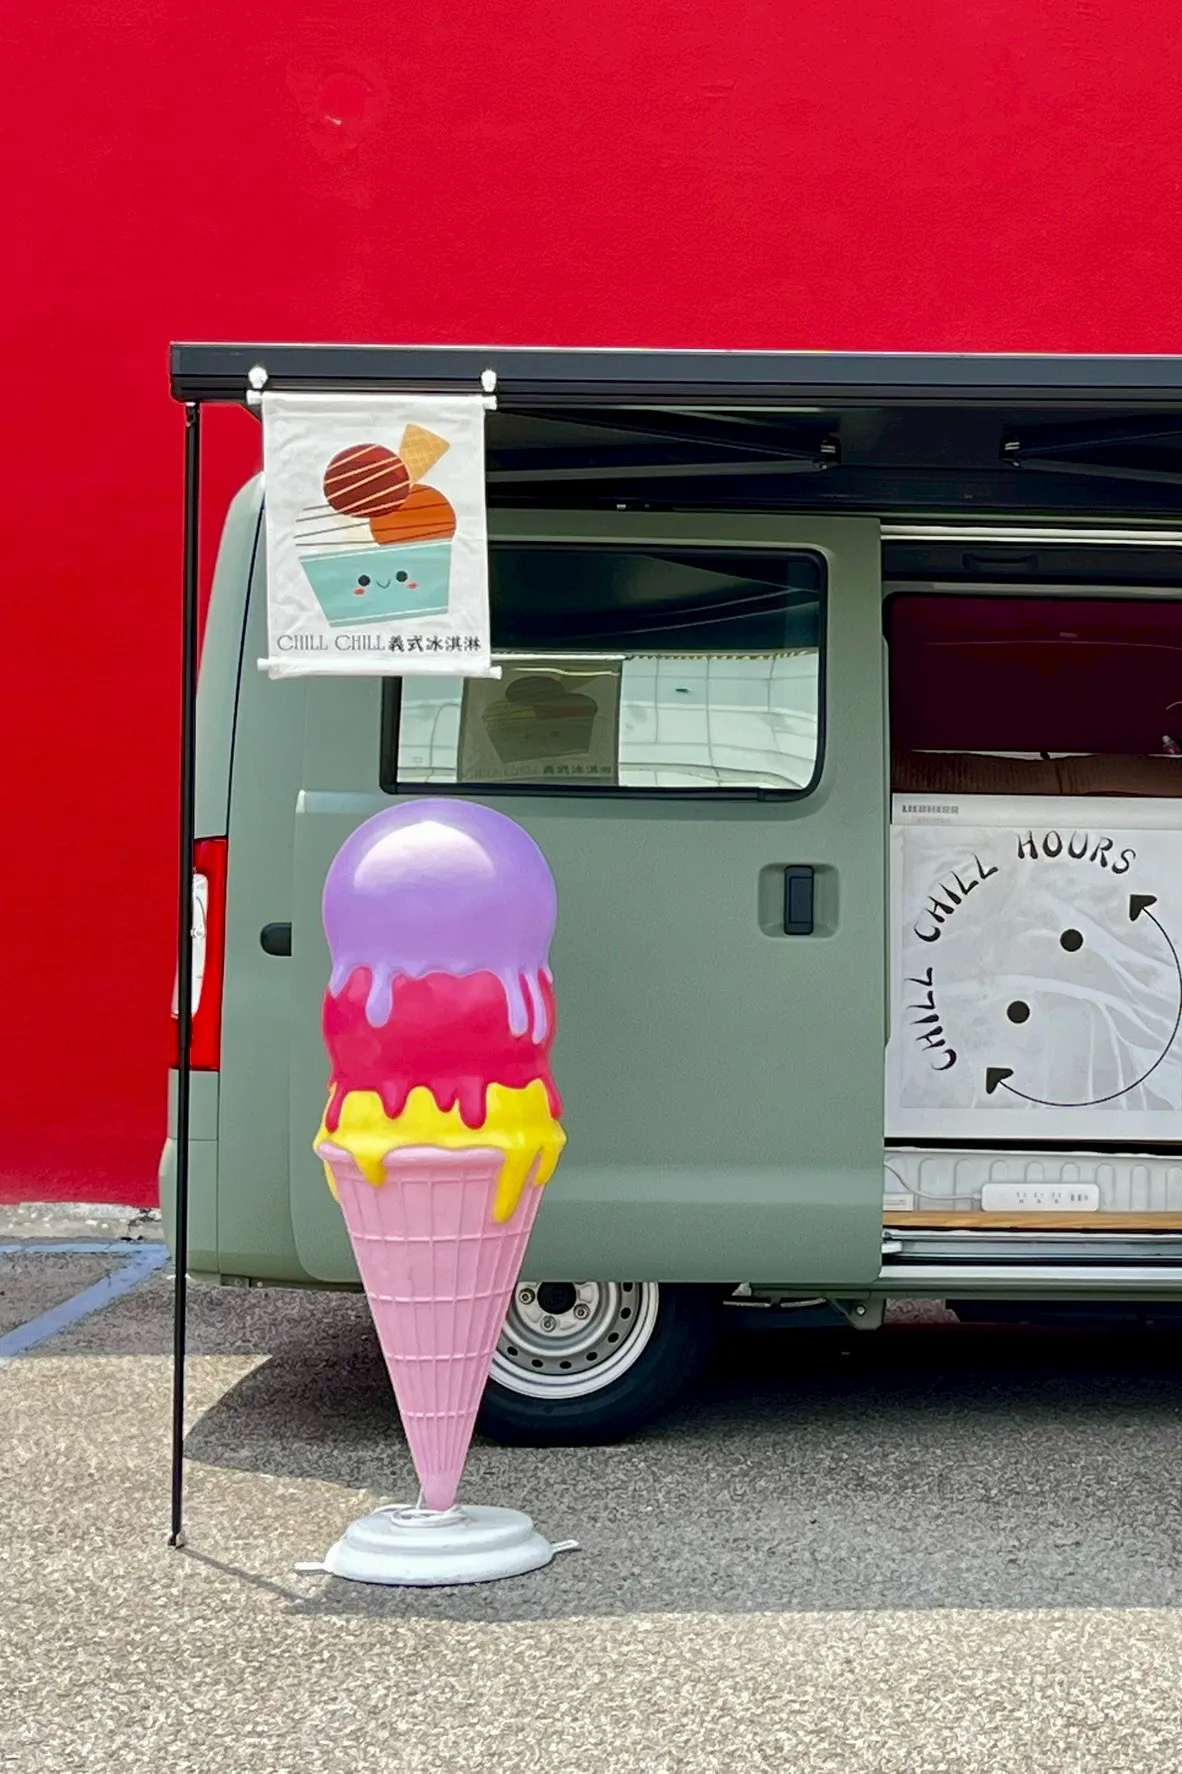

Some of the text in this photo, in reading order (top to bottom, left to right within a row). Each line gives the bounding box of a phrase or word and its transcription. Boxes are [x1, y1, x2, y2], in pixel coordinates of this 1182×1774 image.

[277, 634, 482, 652] CHILL CHILL 義式冰淇淋
[903, 829, 1137, 1072] CHILL CHILL HOURS
